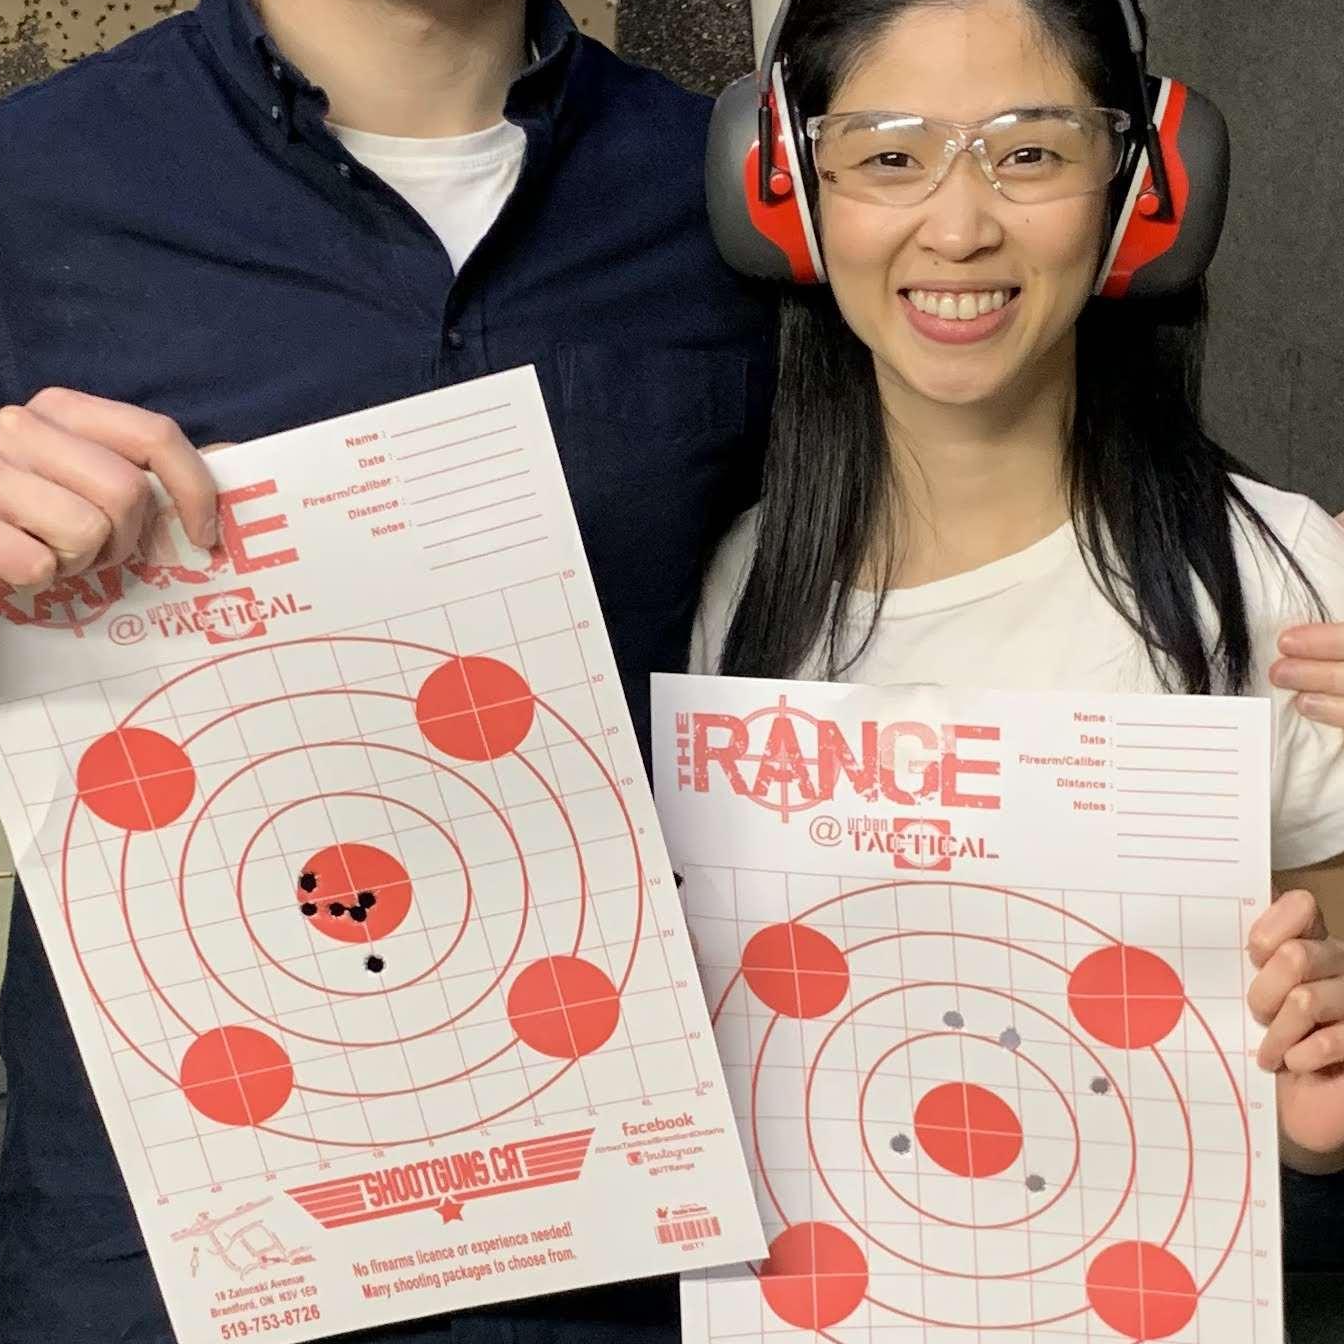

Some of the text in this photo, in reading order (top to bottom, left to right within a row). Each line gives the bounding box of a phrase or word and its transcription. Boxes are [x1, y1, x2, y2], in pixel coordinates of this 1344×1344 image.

[345, 432, 379, 448] Name
[358, 454, 385, 469] Date
[302, 477, 392, 508] Firearm/Caliber
[348, 498, 399, 520] Distance
[371, 521, 405, 537] Notes
[152, 593, 312, 639] TACTICAL
[1073, 712, 1105, 723] Name
[1080, 734, 1106, 745] Date
[676, 712, 1001, 810] THE RANGE
[1019, 754, 1105, 767] Firearm/Caliber
[1056, 778, 1106, 789] Distance
[1073, 801, 1106, 811] Notes
[847, 815, 888, 833] urban
[847, 831, 999, 859] TACTICAL
[622, 1112, 695, 1136] facebook
[366, 1145, 524, 1208] SHOOTGUNS.CA
[352, 1221, 574, 1278] No firearms licence or experience needed!
[270, 1275, 305, 1290] Avenue
[362, 1280, 391, 1299] Many
[394, 1269, 441, 1293] shooting
[442, 1262, 492, 1287] packages
[494, 1259, 506, 1273] to
[508, 1251, 546, 1271] choose
[259, 1295, 275, 1306] ON
[221, 1304, 321, 1340] 519-753-8726
